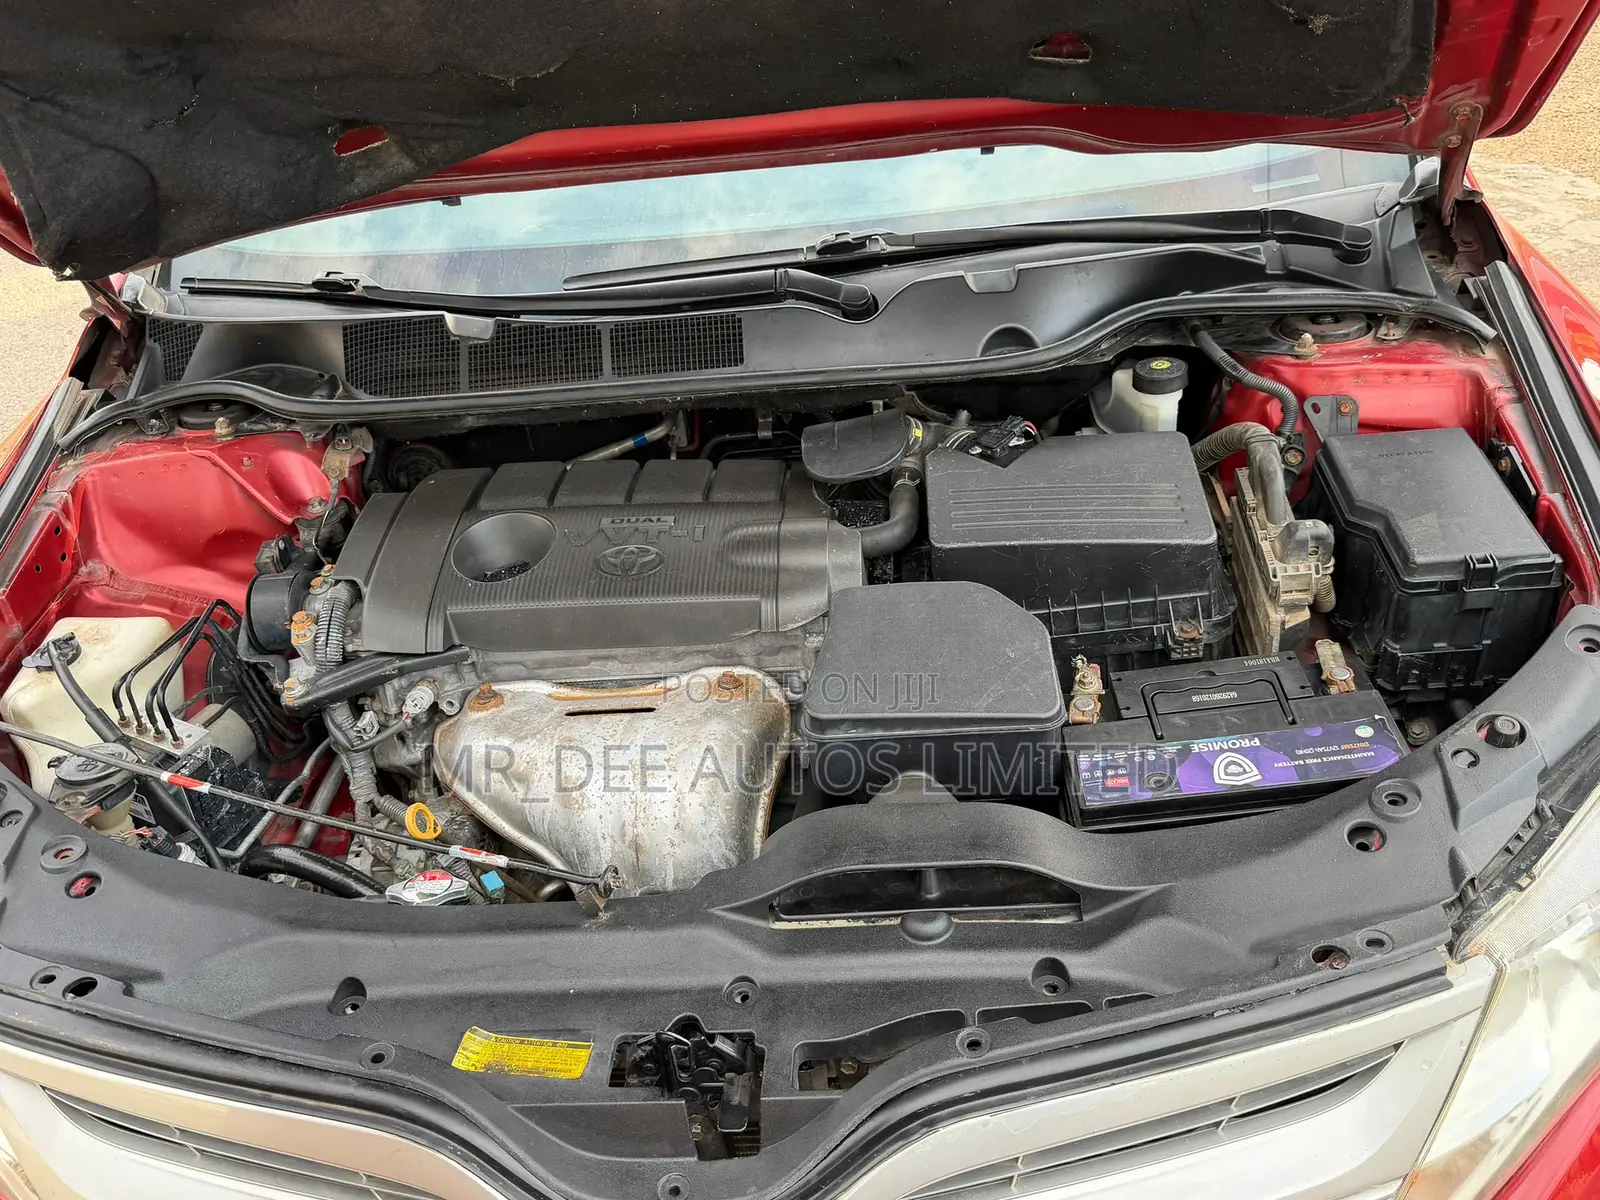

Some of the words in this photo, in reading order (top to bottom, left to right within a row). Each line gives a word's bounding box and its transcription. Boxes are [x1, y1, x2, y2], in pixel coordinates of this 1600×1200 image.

[610, 516, 668, 525] DUAL
[1189, 736, 1261, 752] PROMISE
[1305, 757, 1321, 765] FREE
[1322, 750, 1375, 763] MAINTENANCE
[1273, 759, 1304, 768] BATTERY
[496, 1037, 520, 1045] CAUTION
